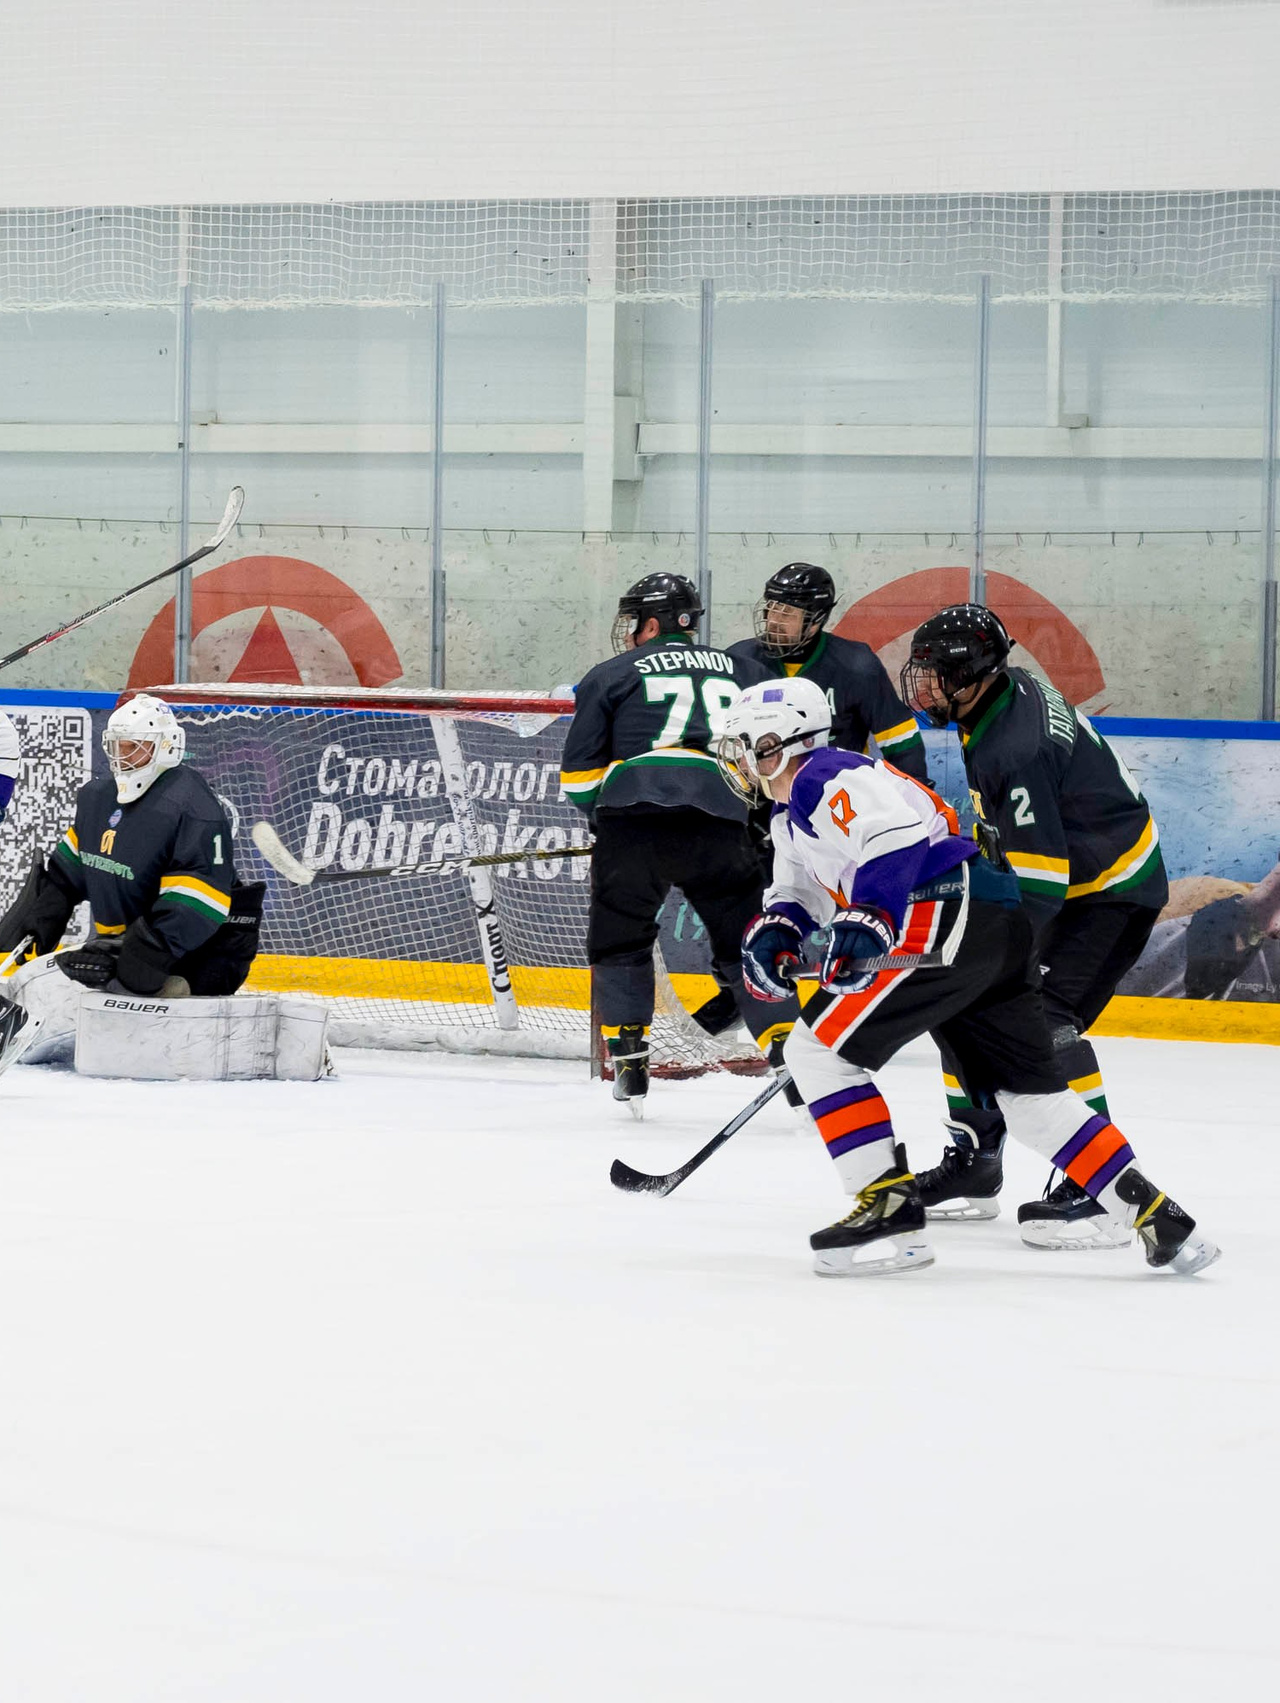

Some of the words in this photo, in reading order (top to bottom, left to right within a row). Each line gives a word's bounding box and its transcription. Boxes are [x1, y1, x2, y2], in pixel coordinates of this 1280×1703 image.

[634, 651, 734, 674] STEPANOV
[827, 787, 857, 837] 17
[1010, 786, 1036, 827] 2
[212, 834, 224, 865] 1
[391, 859, 471, 877] CCM
[486, 922, 512, 993] Спорт
[103, 998, 170, 1015] BAUER
